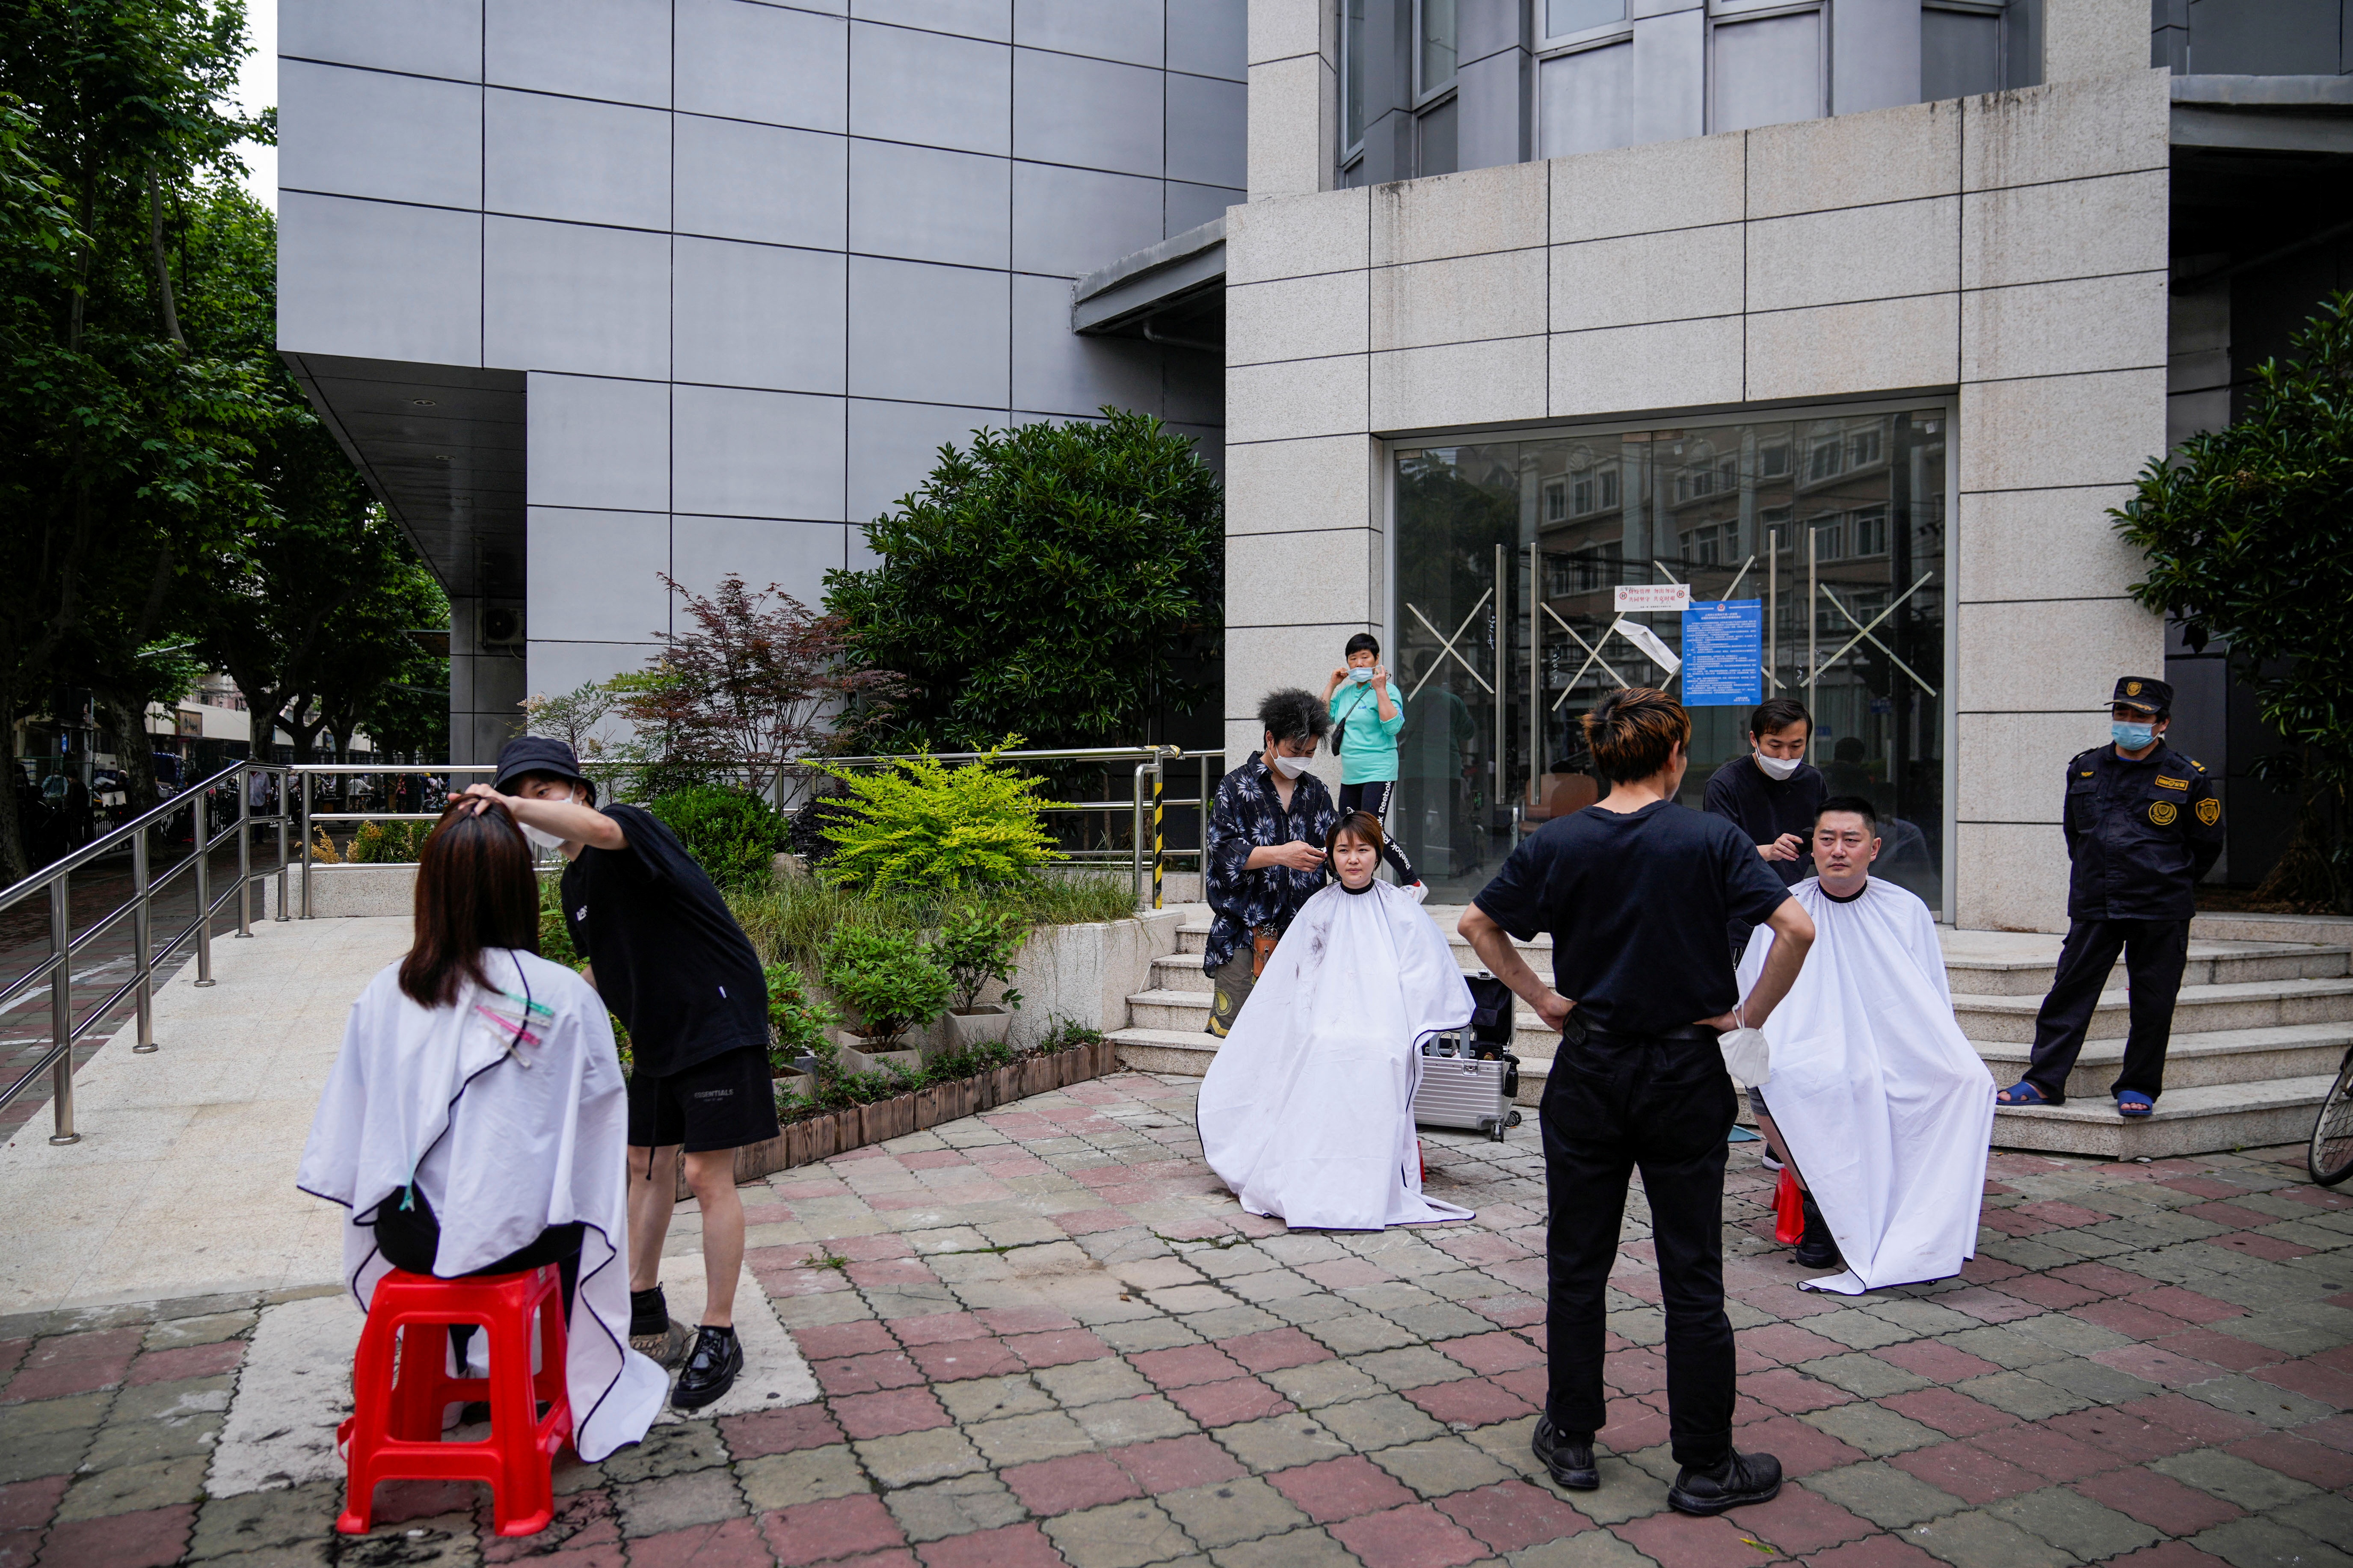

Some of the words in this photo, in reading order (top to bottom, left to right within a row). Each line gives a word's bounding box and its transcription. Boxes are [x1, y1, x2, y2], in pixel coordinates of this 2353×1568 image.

[1379, 781, 1391, 813] Reebok
[1390, 842, 1411, 870] Reebok
[693, 1089, 734, 1098] ESSENTIALS
